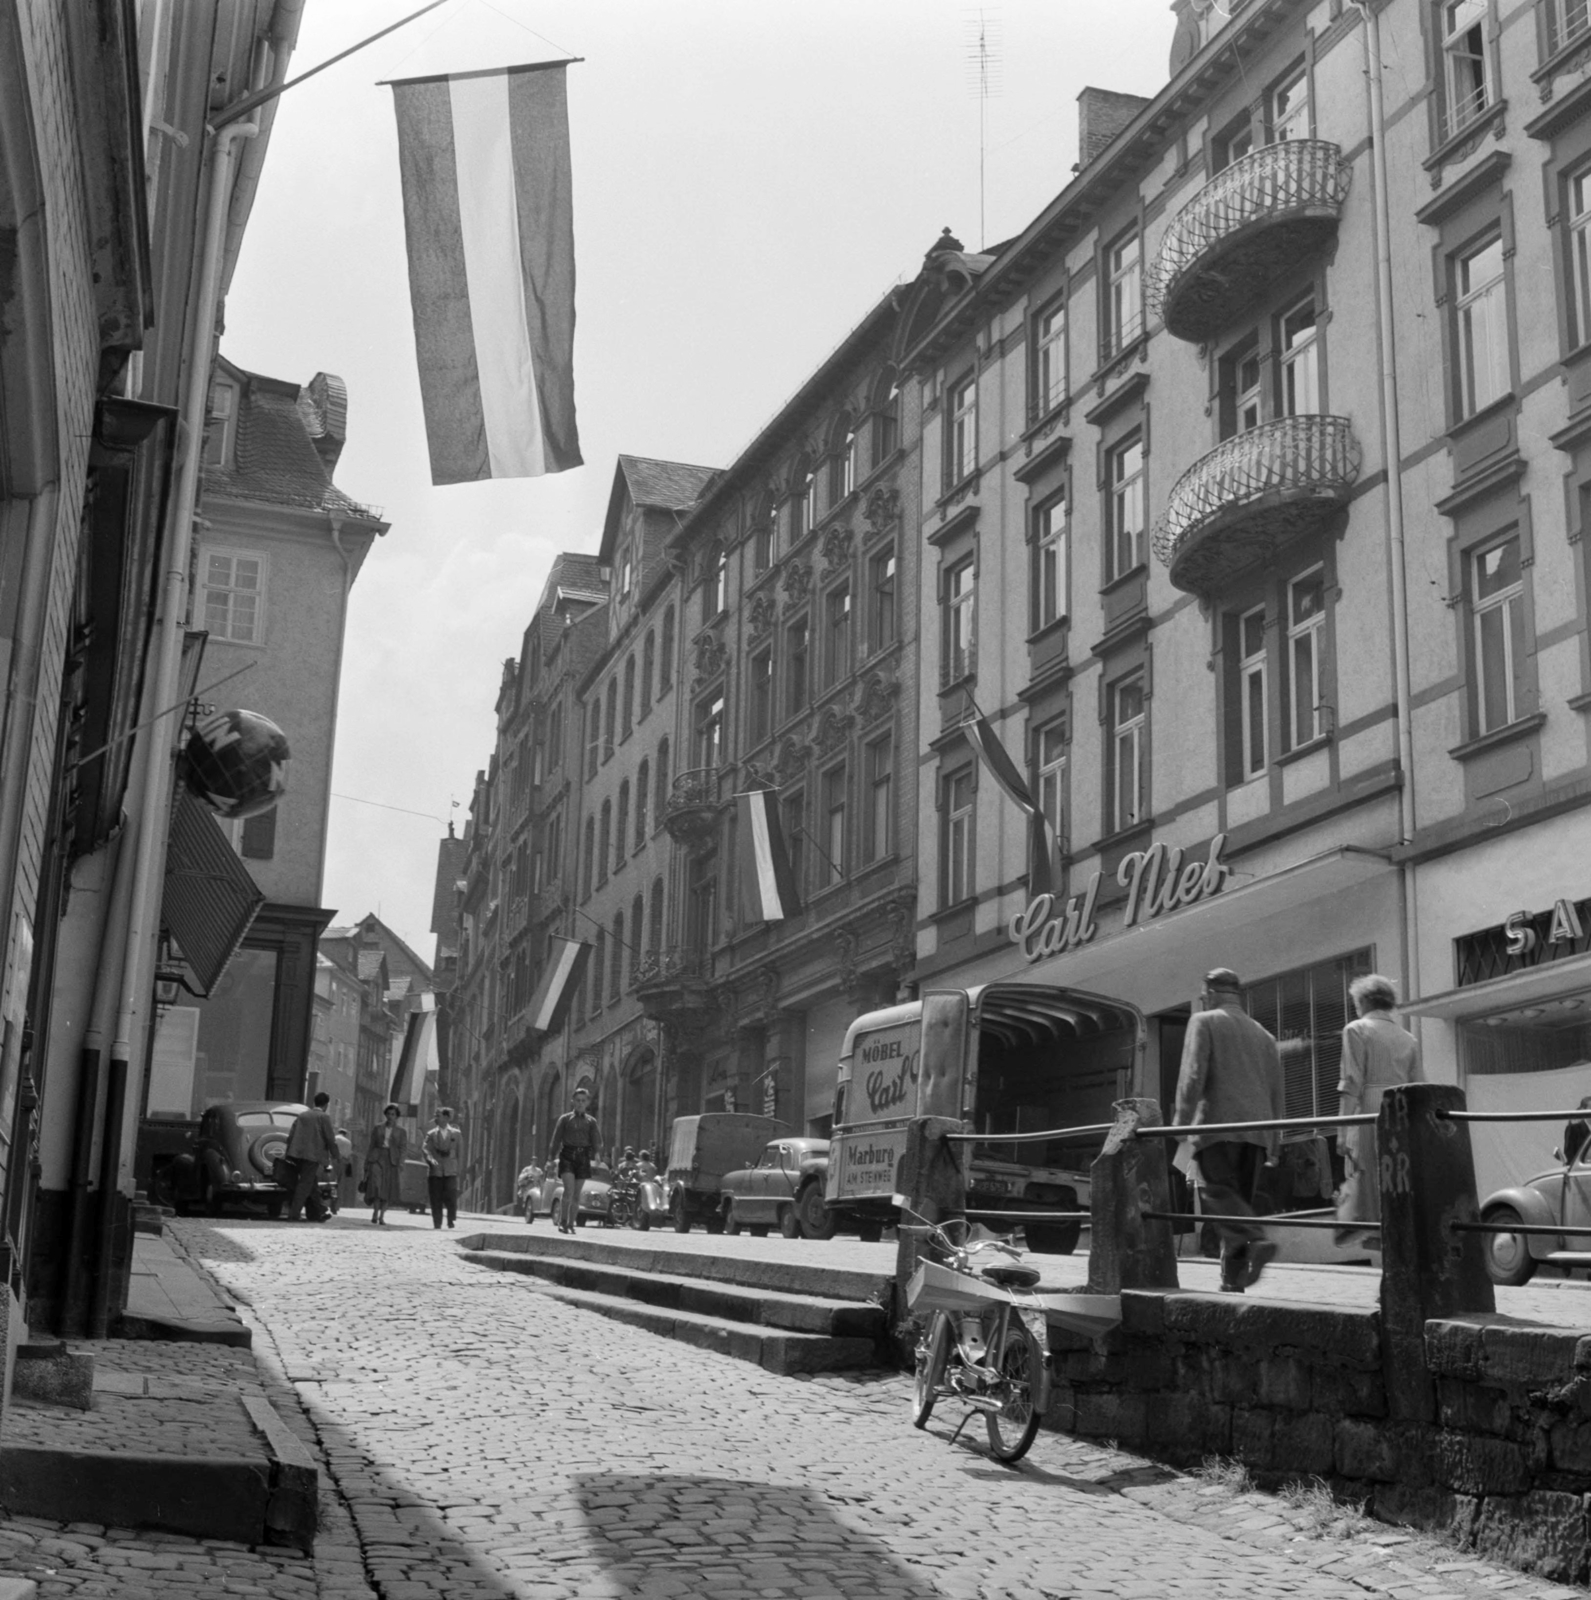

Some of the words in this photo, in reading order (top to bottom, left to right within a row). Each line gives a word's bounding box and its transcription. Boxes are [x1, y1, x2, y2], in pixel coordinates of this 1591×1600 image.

[1009, 870, 1101, 962] Carl
[1118, 833, 1230, 926] Nies
[861, 1038, 904, 1064] MÖBEL
[866, 1054, 910, 1115] Carl
[847, 1144, 895, 1168] Marburg
[847, 1172, 858, 1185] AM
